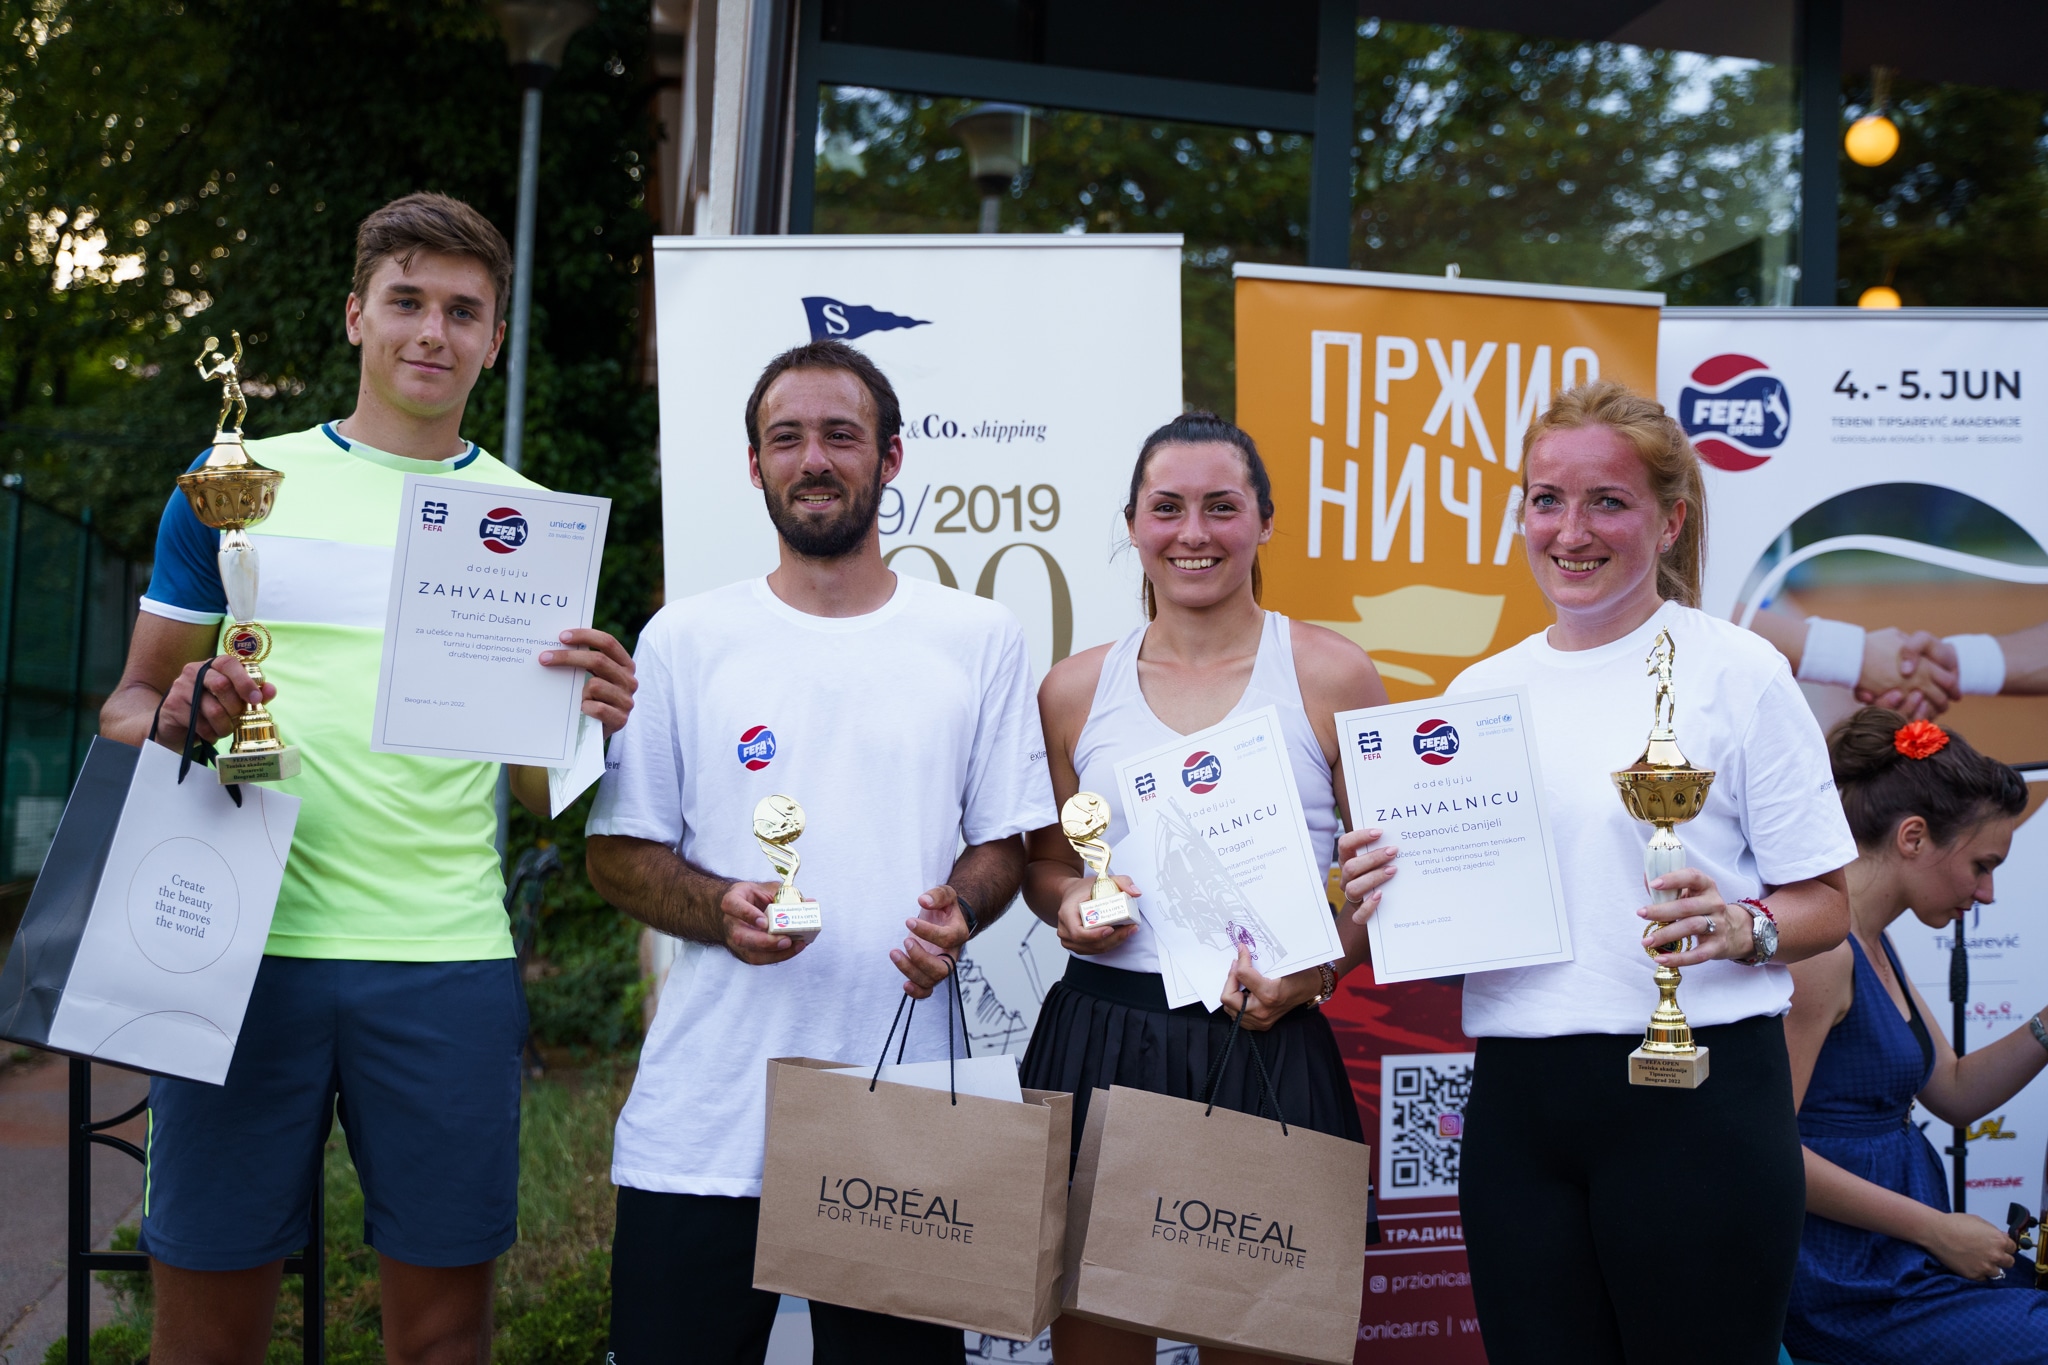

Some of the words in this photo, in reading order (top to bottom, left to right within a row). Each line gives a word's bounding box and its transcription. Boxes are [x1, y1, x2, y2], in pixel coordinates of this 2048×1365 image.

[823, 304, 850, 335] S
[1692, 399, 1765, 425] FEFA
[1832, 417, 1873, 428] TERENI
[1879, 415, 1948, 428] TIPSAREVIĆ
[1952, 417, 2022, 428] AKADEMIJE
[972, 420, 1048, 444] shipping
[1727, 426, 1764, 437] OPEN
[423, 524, 443, 532] FEFA
[485, 524, 517, 536] FEFA
[550, 520, 576, 530] unicef
[467, 564, 529, 578] dodeljuju
[419, 582, 568, 608] ZAHVALNICU
[451, 610, 486, 622] Trunić
[489, 613, 531, 626] Dušanu
[427, 628, 453, 637] učešće
[467, 632, 525, 644] humanitarnom
[527, 638, 562, 648] teniskom
[444, 640, 471, 649] turniru
[476, 642, 515, 654] doprinosu
[516, 646, 532, 656] široj
[449, 650, 490, 662] društvenoj
[491, 655, 525, 664] zajednici
[1477, 715, 1501, 727] unicef
[744, 741, 767, 758] FEFA
[1234, 737, 1255, 751] unicef
[1420, 736, 1449, 750] FEFA
[1364, 753, 1382, 761] FEFA
[1188, 765, 1213, 782] FEFA
[1414, 776, 1473, 790] dodeljuju
[1141, 792, 1157, 803] FEFA
[1187, 798, 1236, 819] dodeljuju
[1376, 791, 1519, 822] ZAHVALNICU
[1201, 804, 1277, 838] ALNICU
[1401, 824, 1459, 840] Stepanović
[1462, 818, 1502, 832] Danijeli
[1218, 836, 1254, 856] Dragani
[1257, 846, 1288, 861] teniskom
[1396, 850, 1421, 859] učešće
[1433, 842, 1489, 853] humanitarnom
[1491, 836, 1526, 846] teniskom
[1415, 858, 1440, 867] turniru
[1446, 851, 1483, 863] doprinosu
[1484, 850, 1500, 859] široj
[1253, 864, 1267, 873] široj
[1422, 865, 1462, 876] društvenoj
[1463, 860, 1496, 871] zajednici
[172, 874, 205, 894] Create
[159, 885, 176, 900] the
[179, 890, 213, 913] beauty
[156, 900, 176, 915] that
[179, 909, 211, 926] moves
[156, 915, 173, 929] the
[176, 923, 206, 939] world
[1934, 934, 2020, 950] Tisarević
[820, 1176, 974, 1228] L'ORÉAL
[818, 1204, 852, 1223] FOR
[859, 1211, 894, 1231] THE
[901, 1219, 974, 1244] FUTURE
[1155, 1197, 1307, 1253] L'ORÉAL
[1385, 1226, 1464, 1243] ТРАДИЦ
[1152, 1225, 1189, 1245] FOR
[1197, 1233, 1231, 1253] THE
[1238, 1243, 1306, 1270] FUTURE
